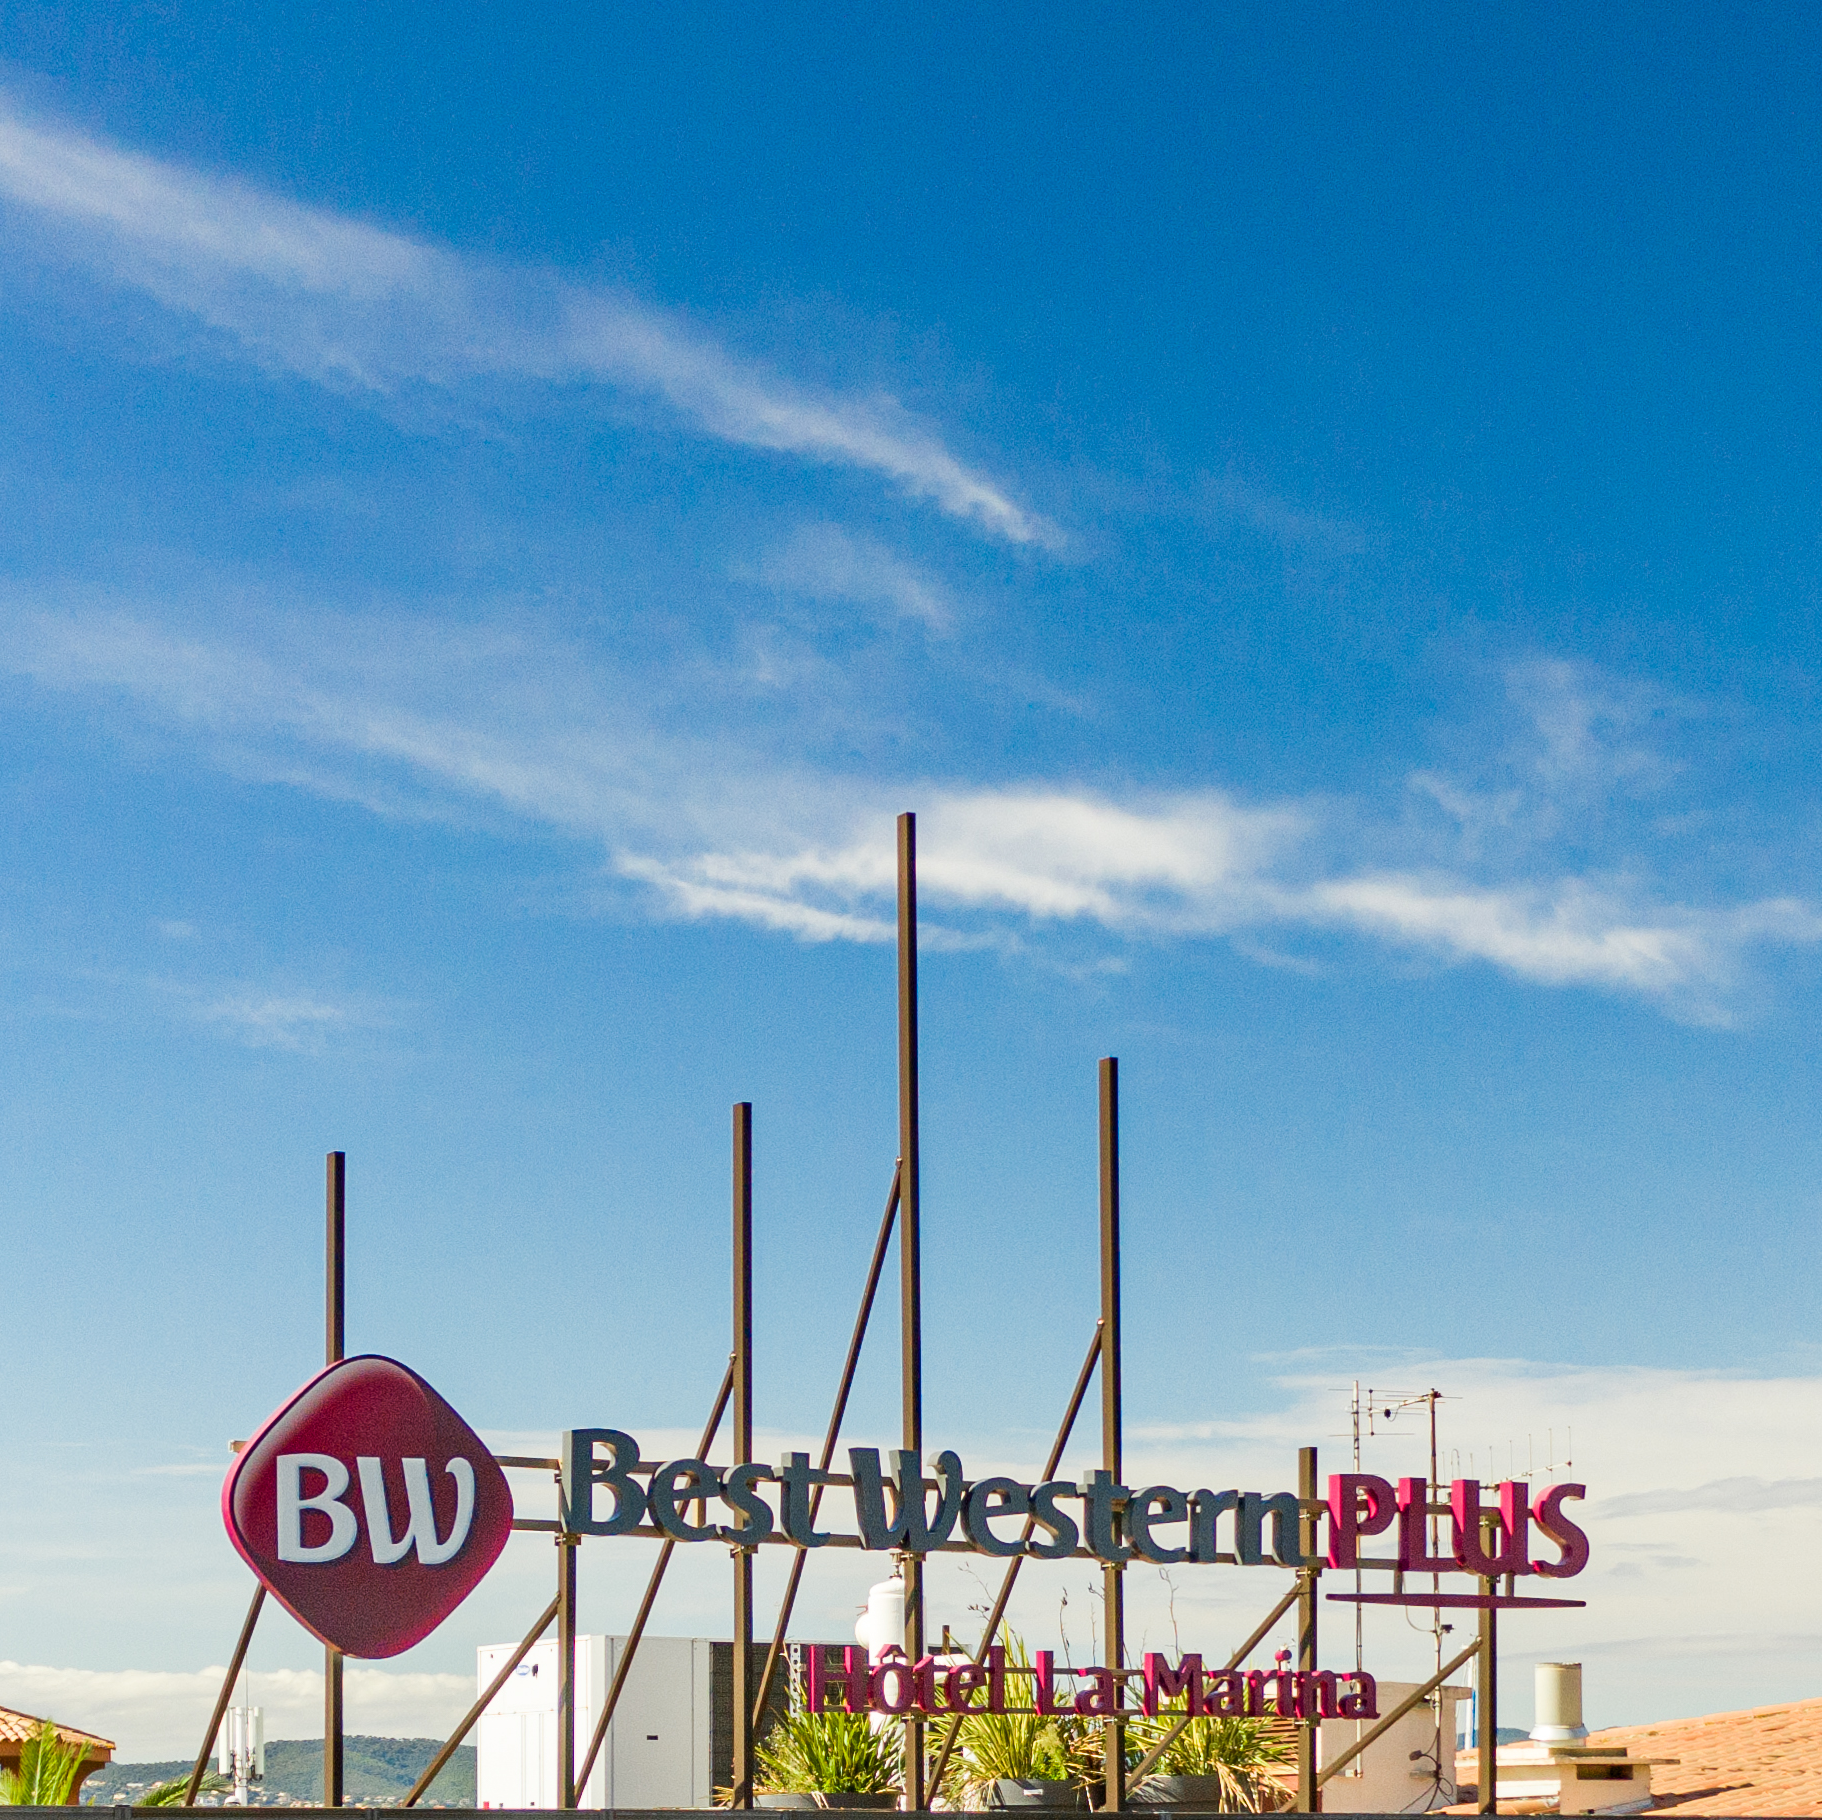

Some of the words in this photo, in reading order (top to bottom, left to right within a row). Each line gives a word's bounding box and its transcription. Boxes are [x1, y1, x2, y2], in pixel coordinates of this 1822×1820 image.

[276, 1453, 475, 1565] BW
[561, 1428, 831, 1548] Best
[847, 1446, 1312, 1567] Western
[1327, 1473, 1590, 1579] PLUS
[808, 1643, 1006, 1715] Hôtel
[1034, 1650, 1121, 1717] La
[1142, 1648, 1380, 1718] Marina
